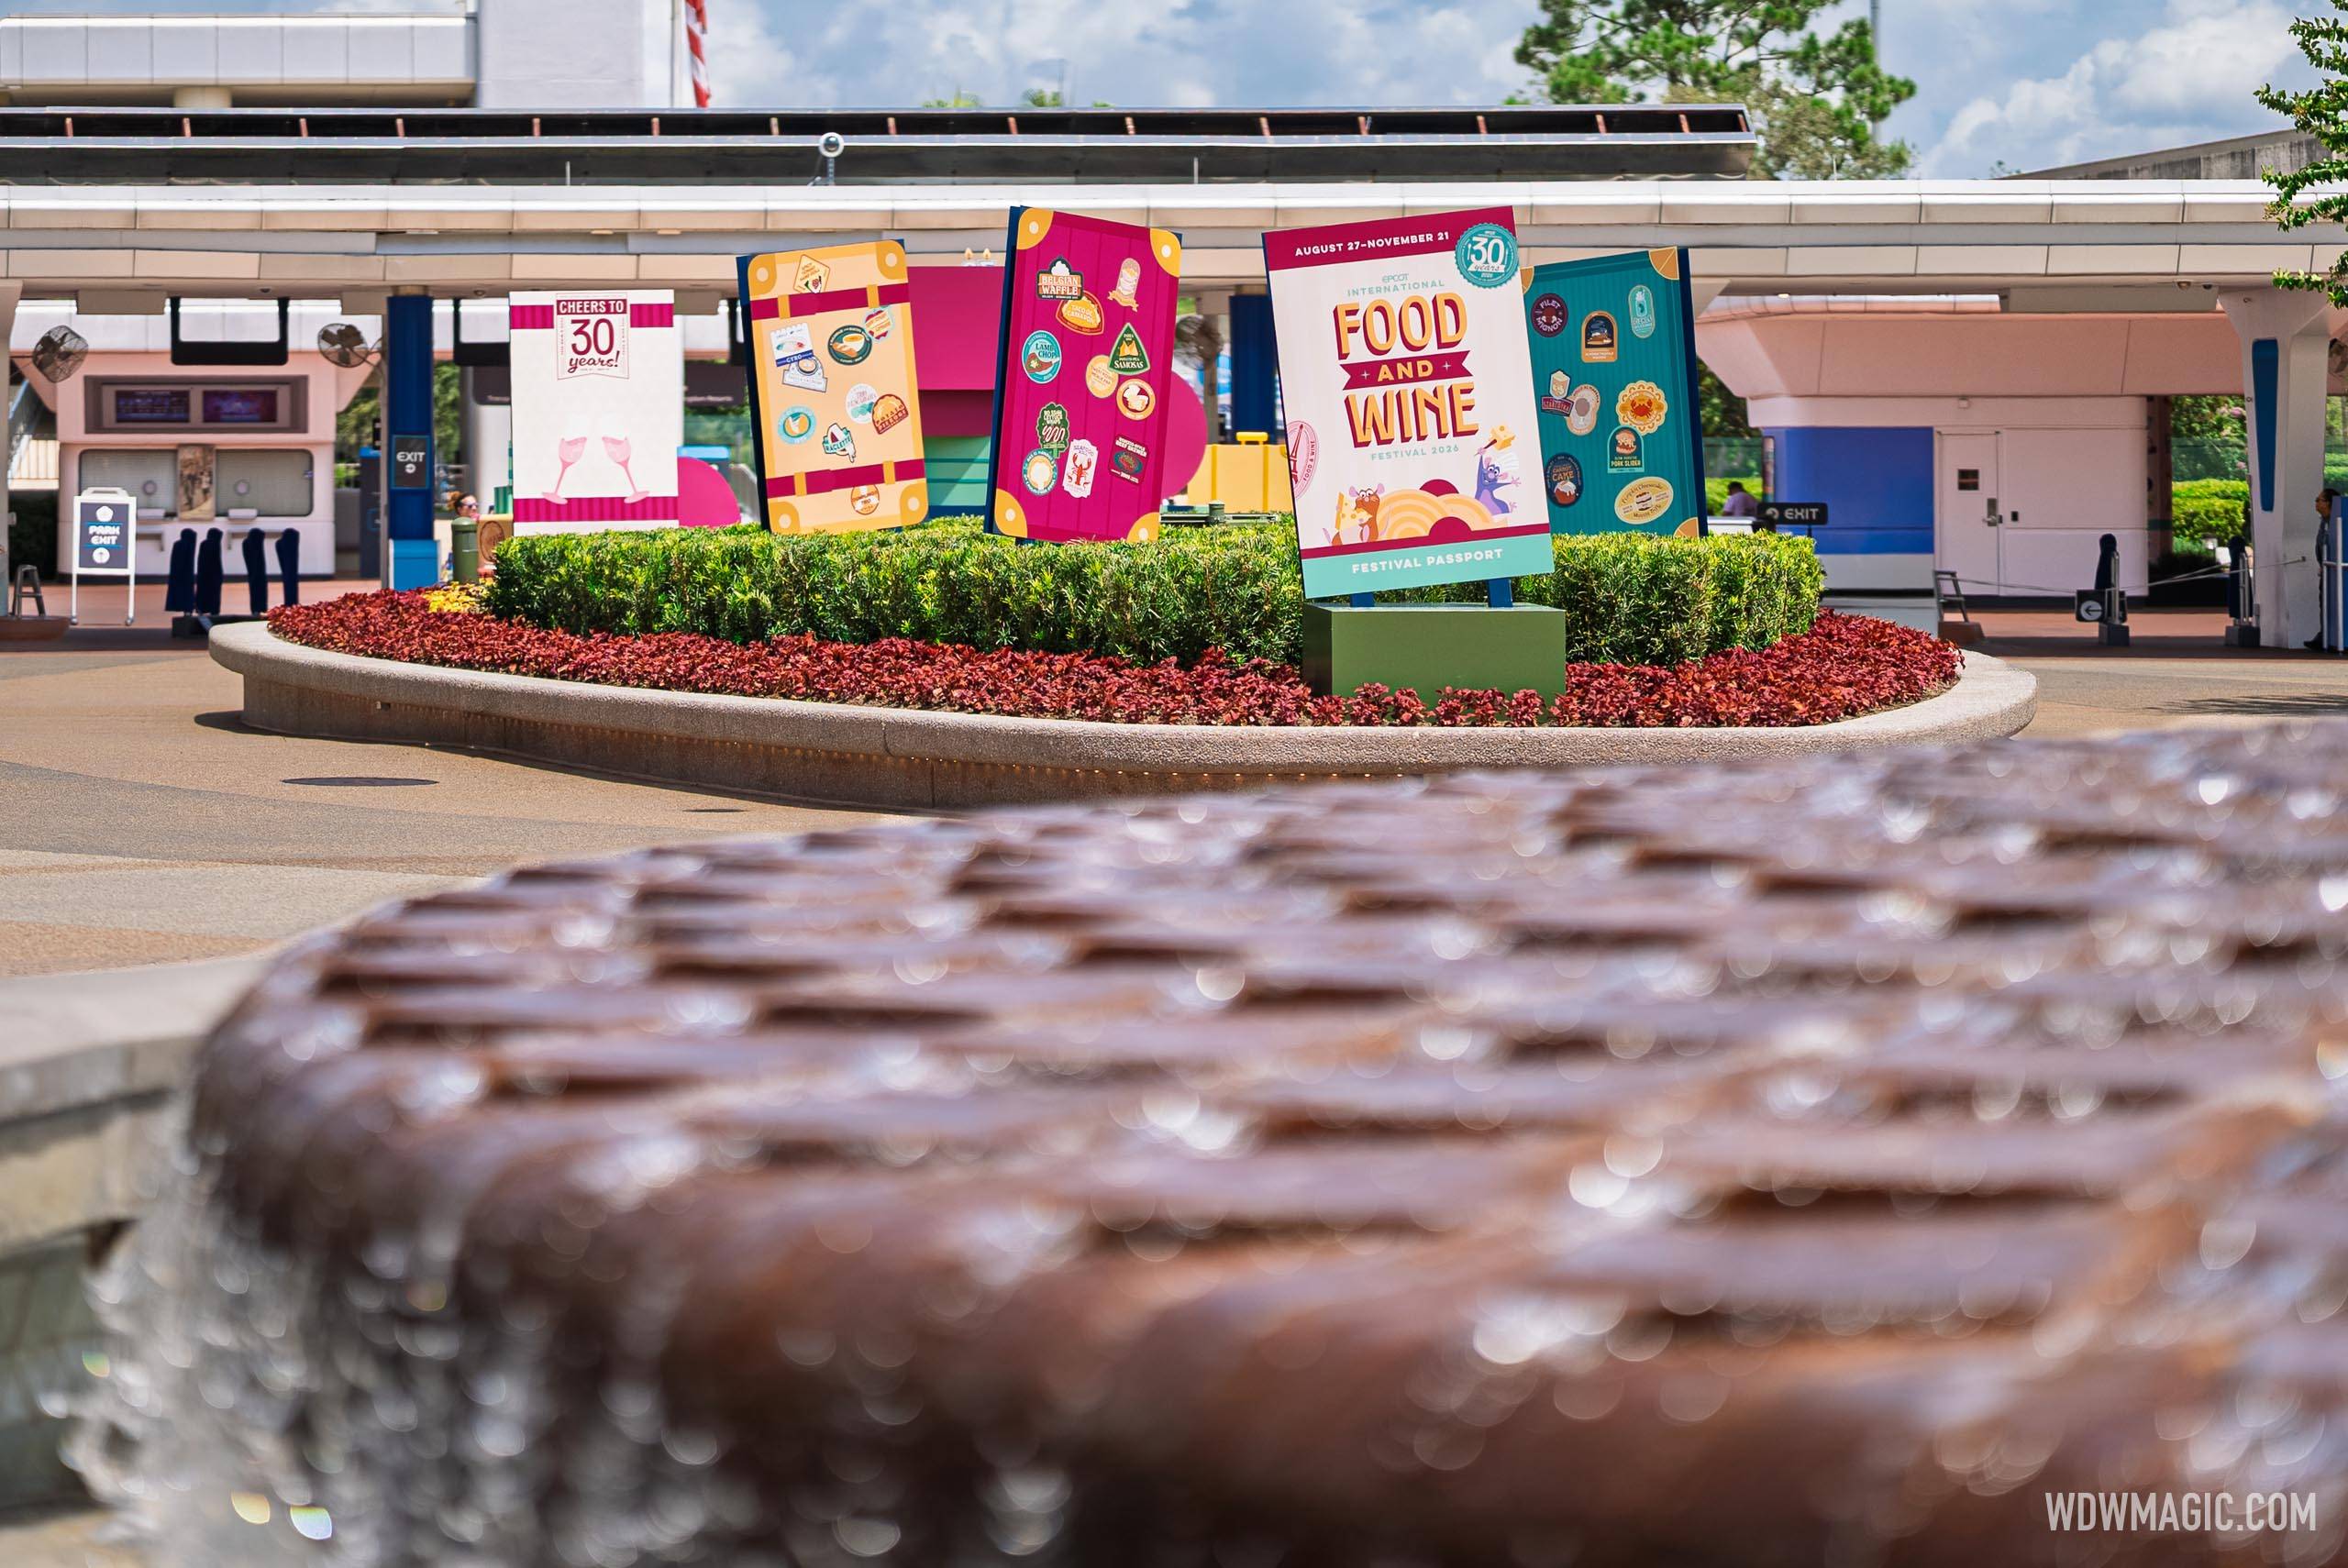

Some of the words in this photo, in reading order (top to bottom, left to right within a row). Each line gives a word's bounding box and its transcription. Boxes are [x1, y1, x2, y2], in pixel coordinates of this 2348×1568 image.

[1295, 243, 1344, 257] AUGUST
[1437, 231, 1449, 241] 21
[1470, 236, 1505, 265] 30
[1041, 275, 1079, 285] BELGIAN
[1381, 273, 1409, 283] EPCOT
[1041, 285, 1079, 296] WAFFLE
[1346, 280, 1445, 297] INTERNATIONAL
[559, 300, 607, 314] CHEERS
[608, 300, 625, 313] TO
[1540, 299, 1561, 309] FILET
[1333, 292, 1468, 360] FOOD
[1535, 316, 1563, 332] MIGNON
[570, 317, 615, 356] 30
[1036, 343, 1054, 352] LAMB
[567, 350, 621, 373] years!
[1113, 359, 1145, 369] SAMOSAS
[1377, 359, 1434, 382] AND
[1344, 381, 1479, 448] WINE
[395, 451, 426, 462] EXIT
[1370, 447, 1427, 461] FESTIVAL
[1431, 444, 1459, 455] 2026
[1552, 470, 1575, 481] CAKE
[1784, 507, 1820, 520] EXIT
[88, 525, 121, 536] PARK
[90, 535, 118, 545] EXIT
[1351, 558, 1422, 574] FESTIVAL
[1426, 548, 1503, 566] PASSPORT
